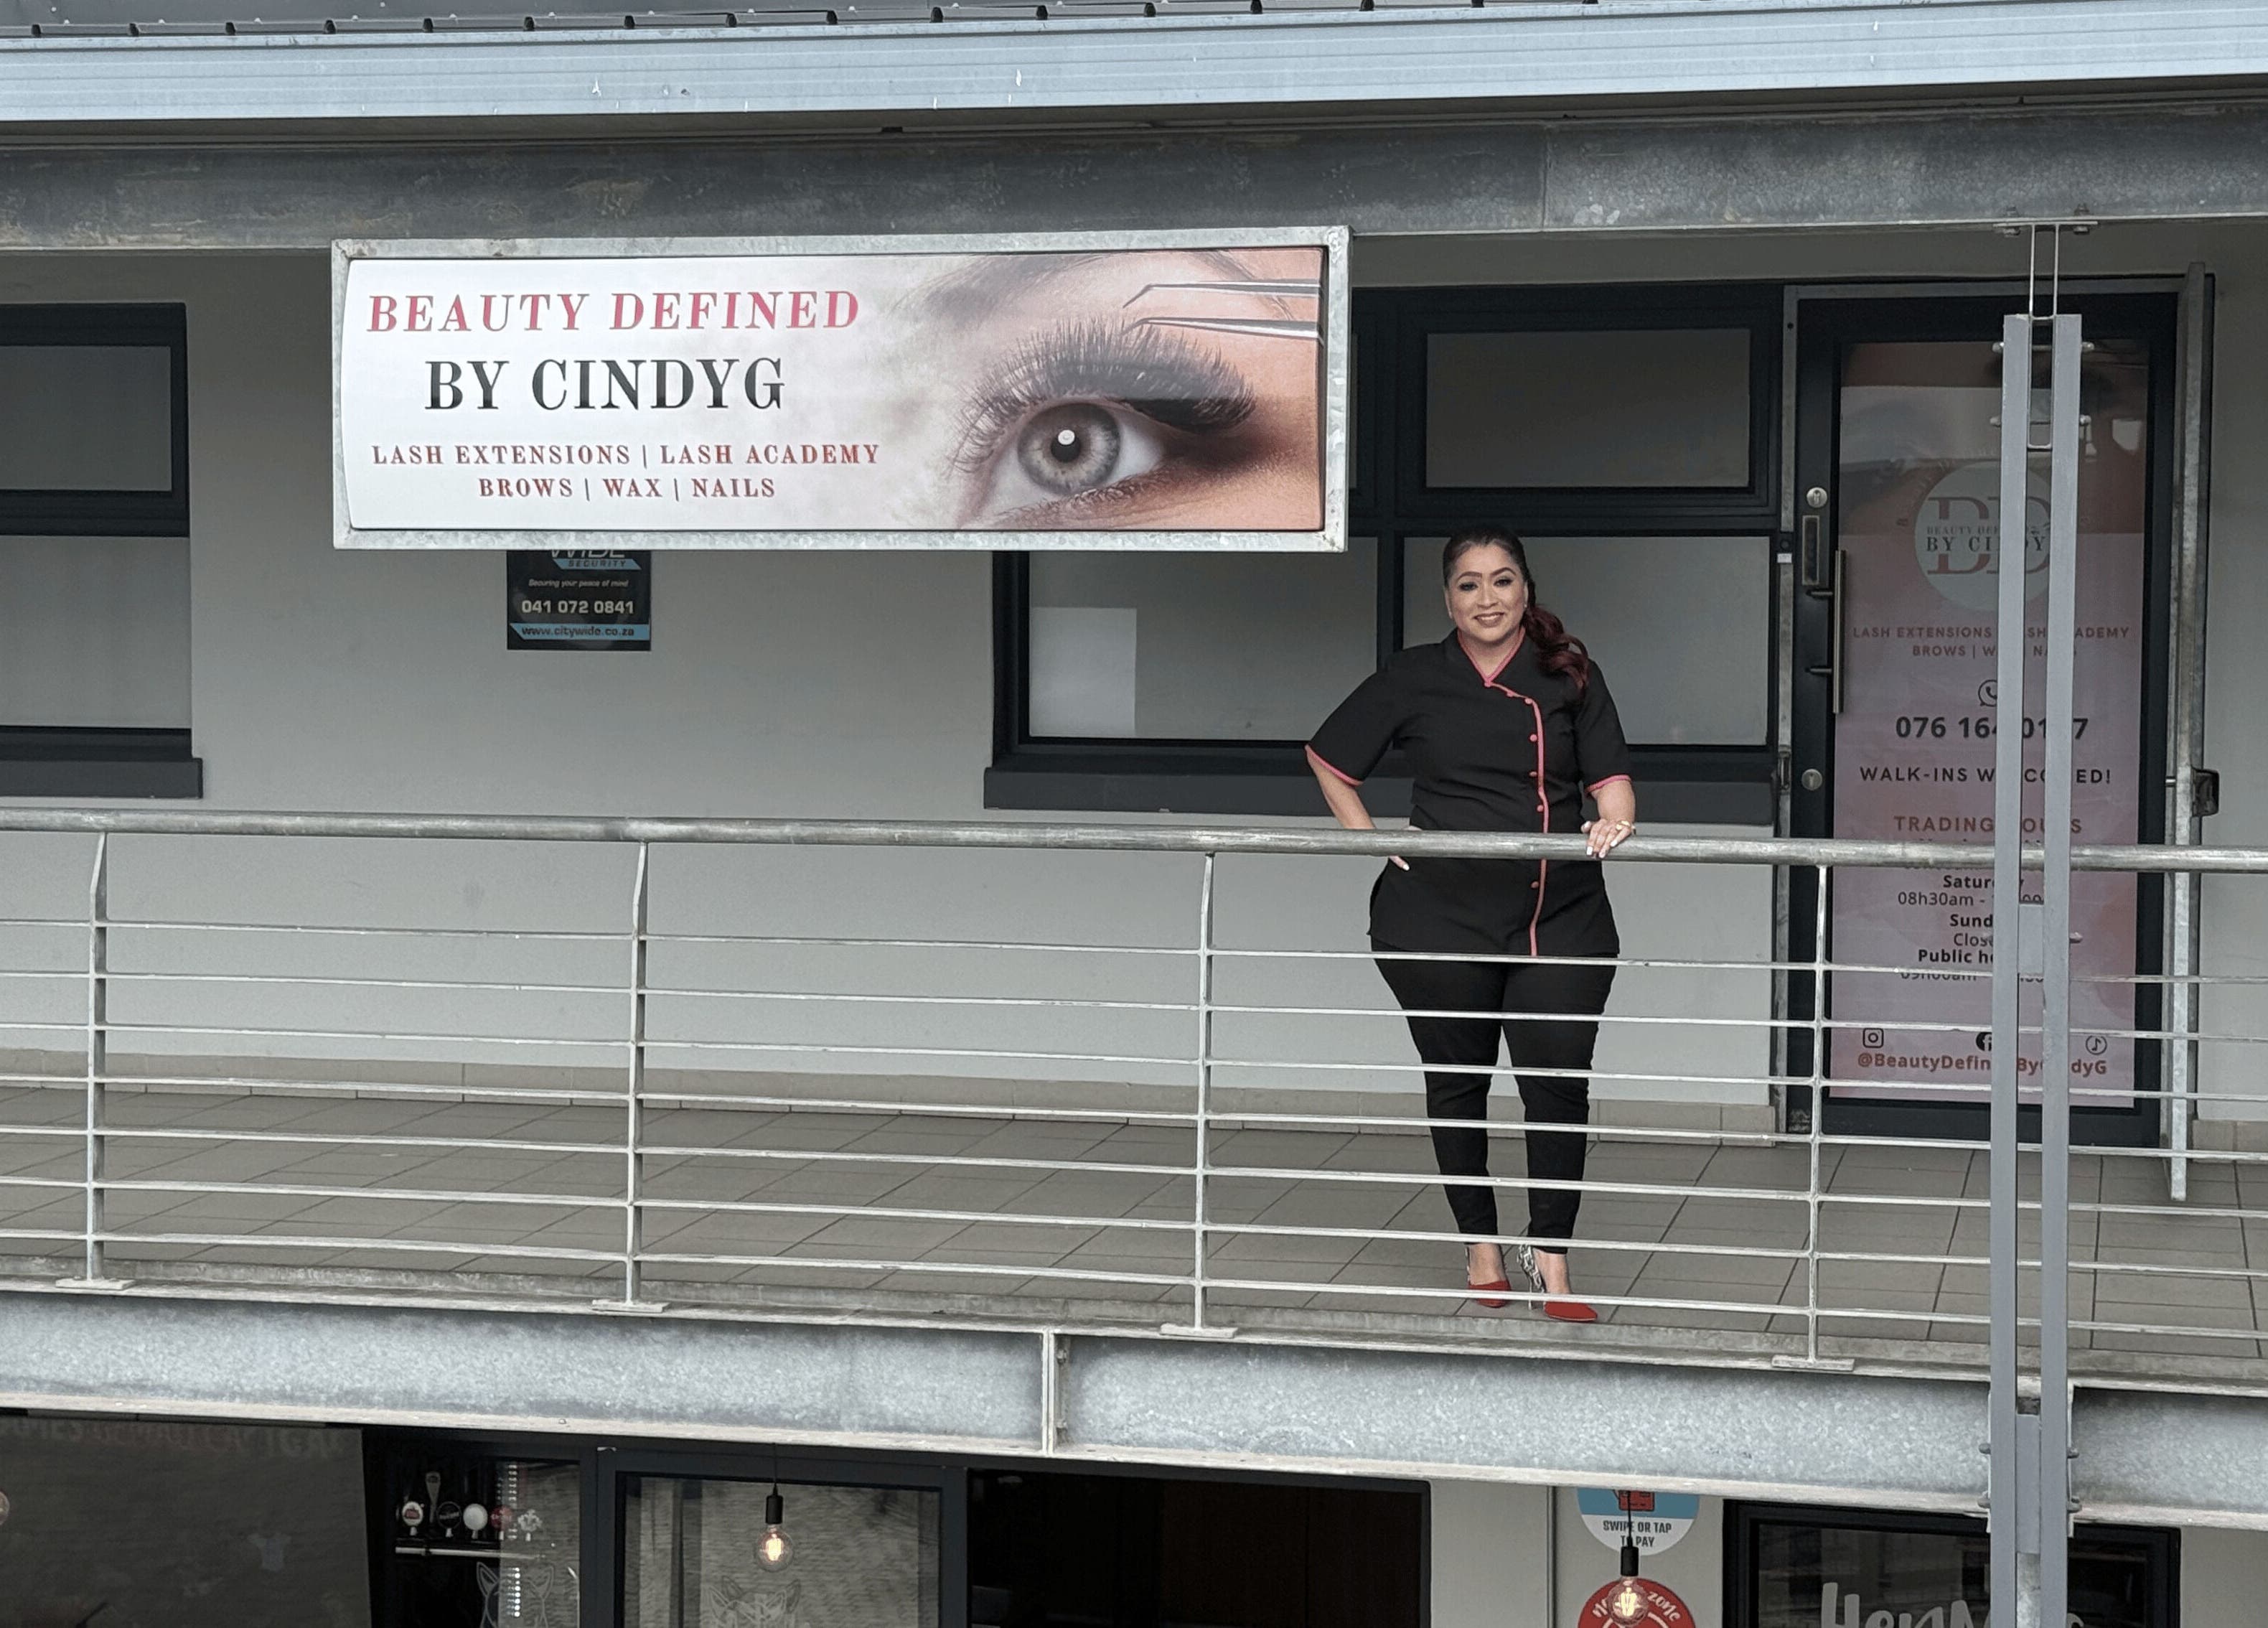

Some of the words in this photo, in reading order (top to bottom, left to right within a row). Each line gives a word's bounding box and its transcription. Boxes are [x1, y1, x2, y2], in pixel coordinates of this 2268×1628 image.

[367, 293, 589, 332] BEAUTY
[609, 290, 859, 331] DEFINED
[425, 360, 510, 410] BY
[532, 357, 784, 410] CINDYG
[372, 445, 443, 465] LASH
[456, 445, 630, 465] EXTENSIONS
[660, 444, 732, 464] LASH
[746, 444, 880, 464] ACADEMY
[478, 478, 573, 497] BROWS
[603, 478, 663, 497] WAX
[692, 477, 776, 497] NAILS
[1927, 537, 1954, 551] BY
[528, 579, 560, 587] Securing
[522, 600, 551, 613] 041
[558, 600, 589, 613] 072
[594, 601, 634, 613] 0841
[522, 625, 634, 637] www.citywide.co.za
[1853, 627, 1890, 638] LASH
[1897, 627, 1992, 638] EXTENSIONS
[1913, 645, 1966, 656] BROWS
[1896, 716, 1946, 739] 076
[1860, 767, 1967, 782] WALK-INS
[1894, 816, 1994, 833] TRADING
[1898, 892, 1974, 906] 08h30am
[1950, 914, 1992, 927] Sund
[1918, 949, 1972, 964] Public
[1637, 1522, 1651, 1533] OR
[1654, 1522, 1672, 1533] TAP
[1636, 1536, 1654, 1547] PAY
